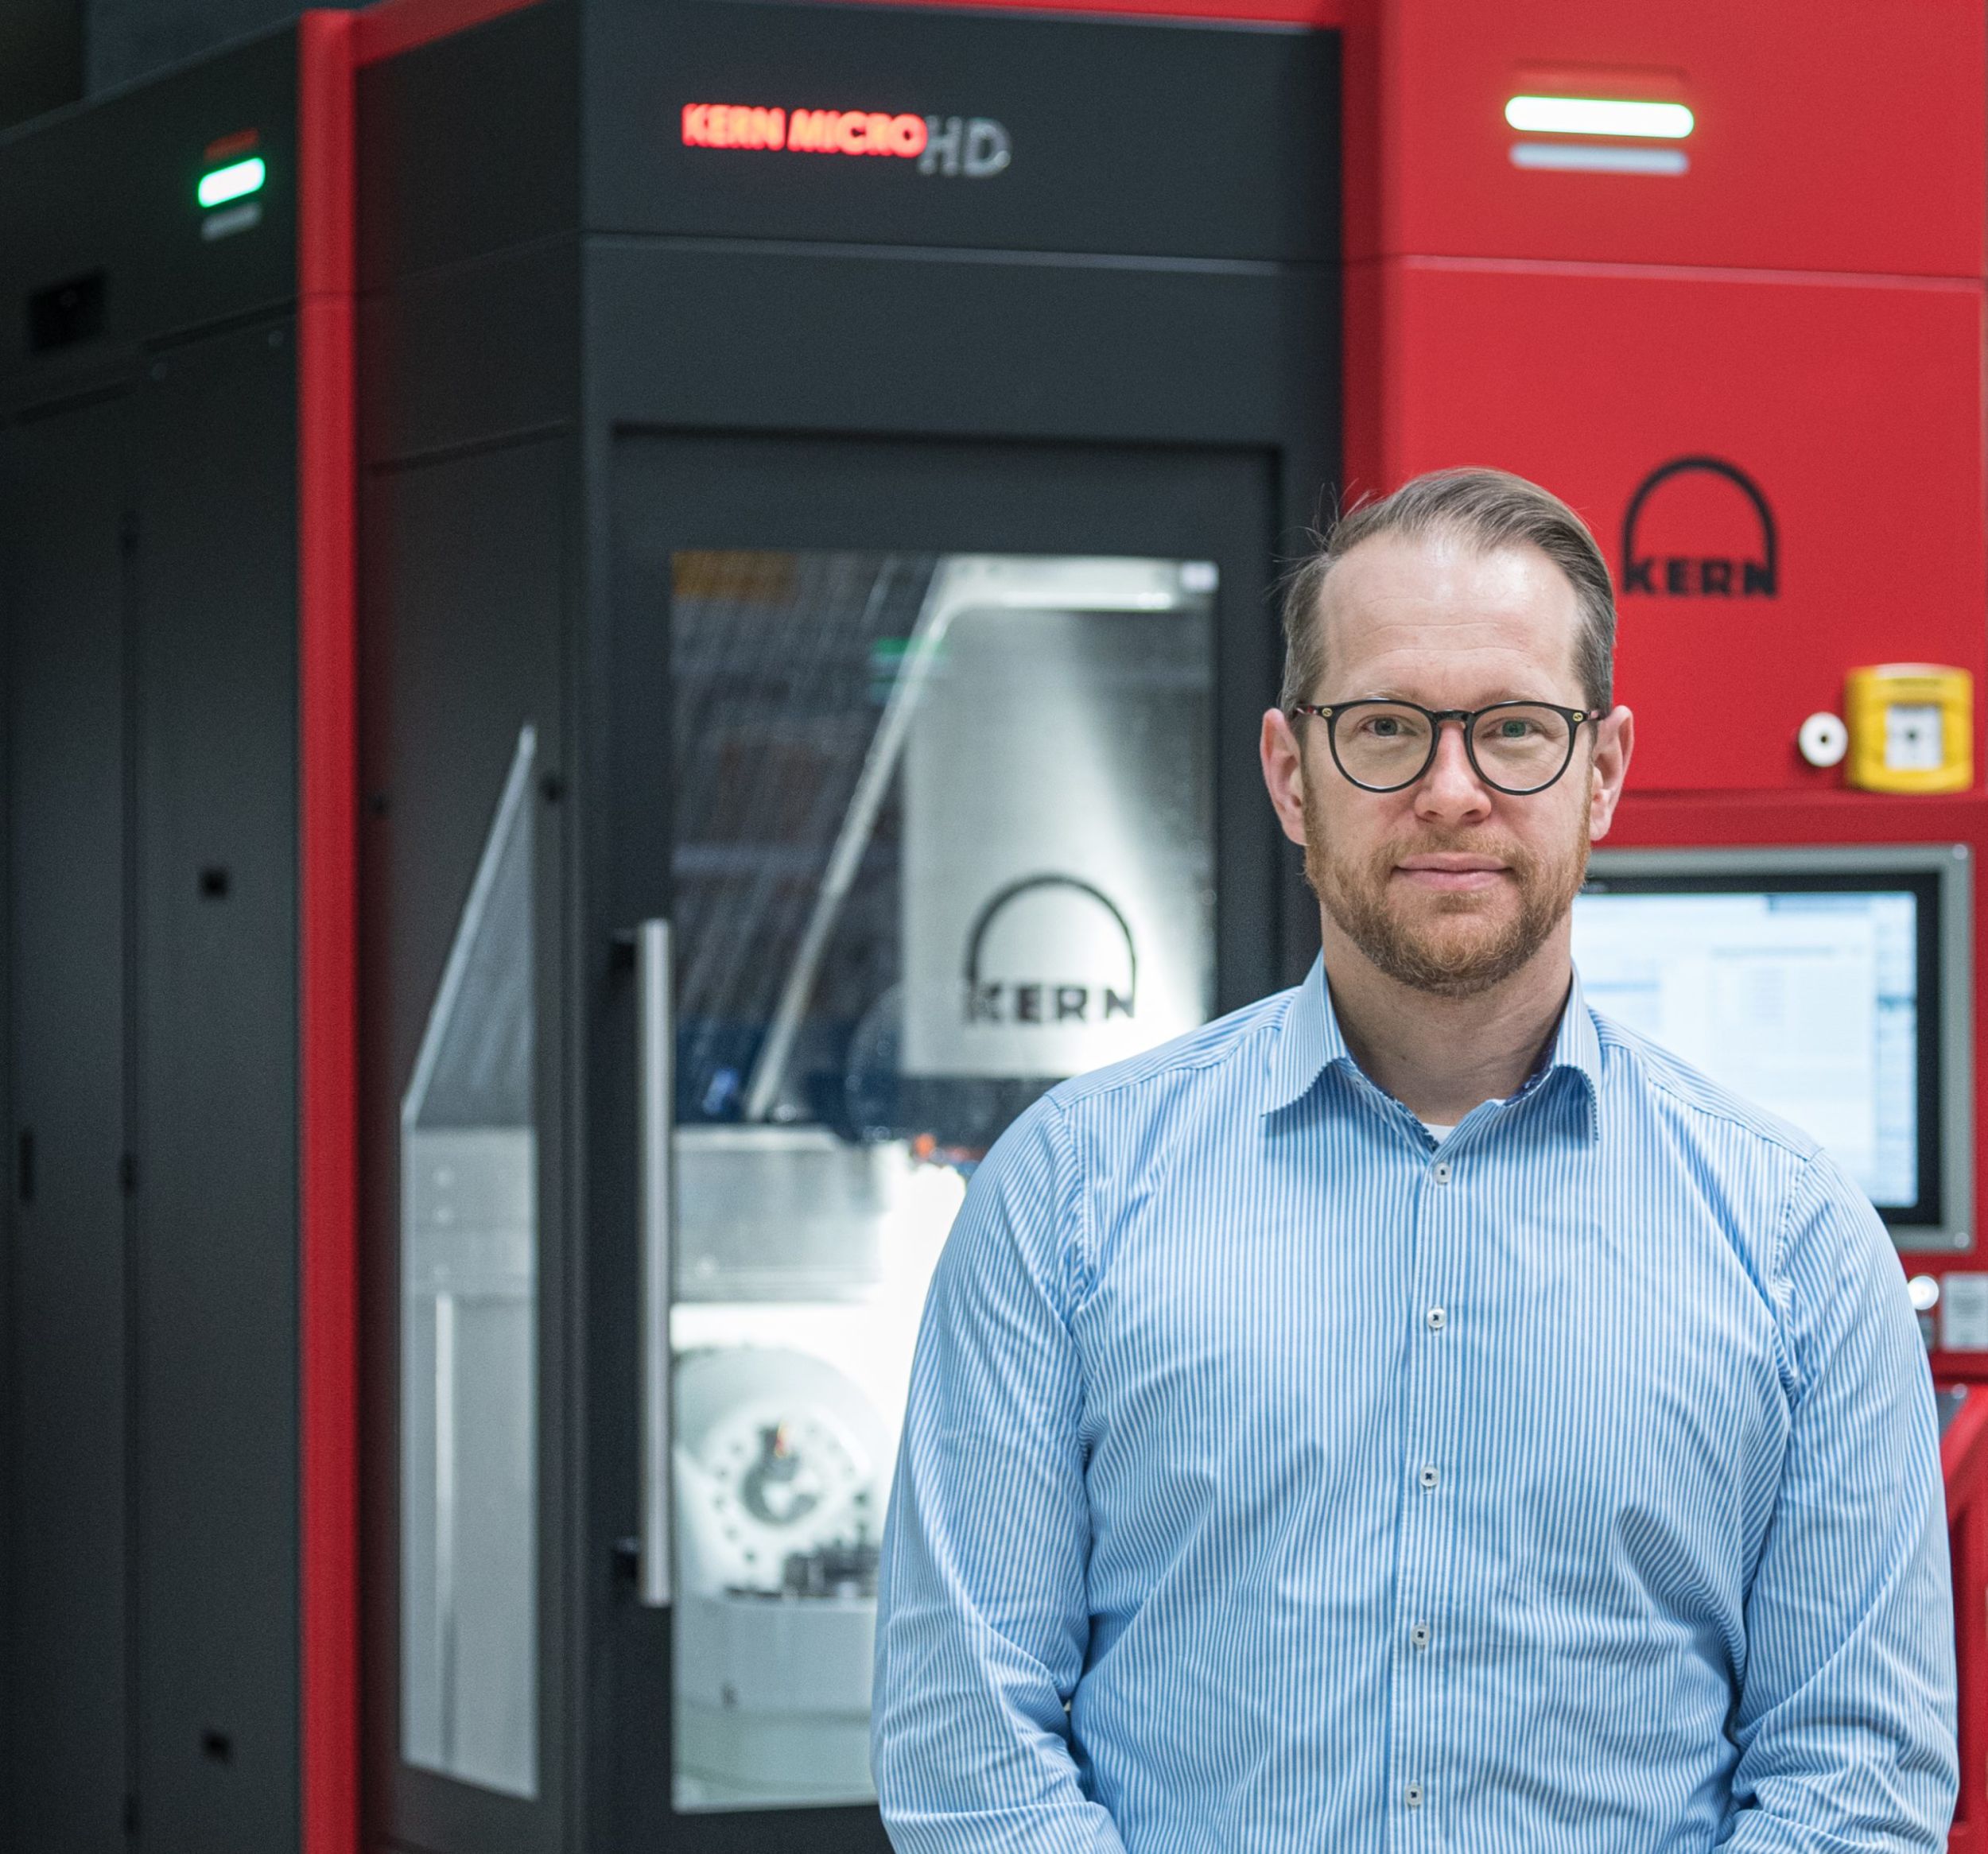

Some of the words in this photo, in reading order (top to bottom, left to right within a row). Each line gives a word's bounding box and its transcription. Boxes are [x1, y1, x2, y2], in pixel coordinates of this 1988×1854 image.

[682, 103, 786, 151] KERN
[787, 108, 928, 157] MICRO
[1623, 558, 1778, 596] KERN
[964, 983, 1136, 1025] KERN
